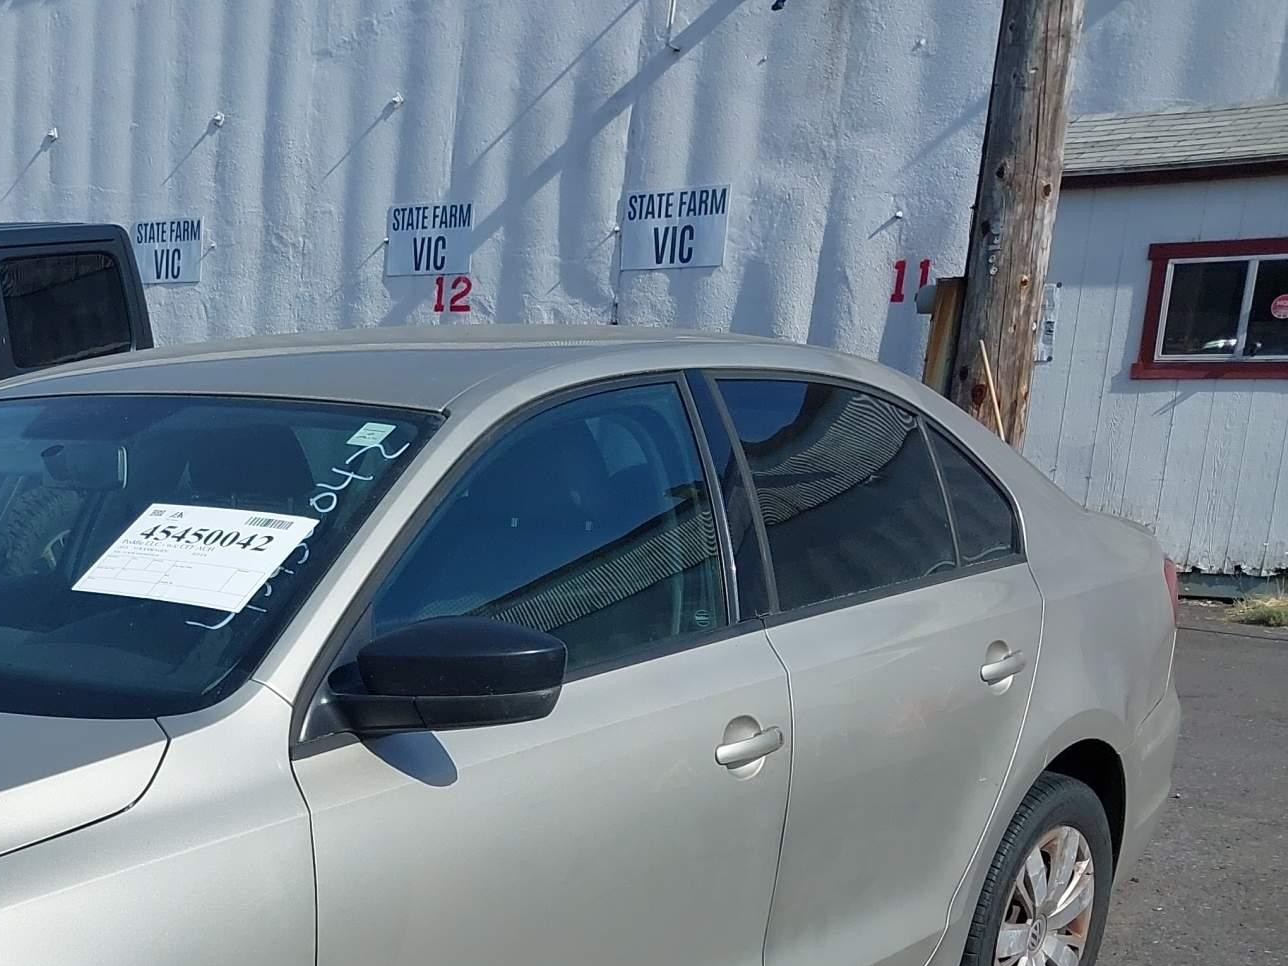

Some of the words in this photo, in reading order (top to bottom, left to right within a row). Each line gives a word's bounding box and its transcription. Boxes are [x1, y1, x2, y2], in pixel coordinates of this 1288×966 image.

[393, 206, 429, 231] STATE
[432, 203, 472, 229] FARM
[628, 192, 674, 220] STATE
[678, 188, 727, 217] FARM
[137, 221, 168, 244] STATE
[169, 219, 201, 241] FARM
[653, 224, 694, 265] VIC
[154, 248, 181, 280] VIC
[413, 235, 446, 272] VIC
[433, 275, 473, 313] 12
[890, 259, 931, 303] 11
[140, 524, 275, 552] 45450042
